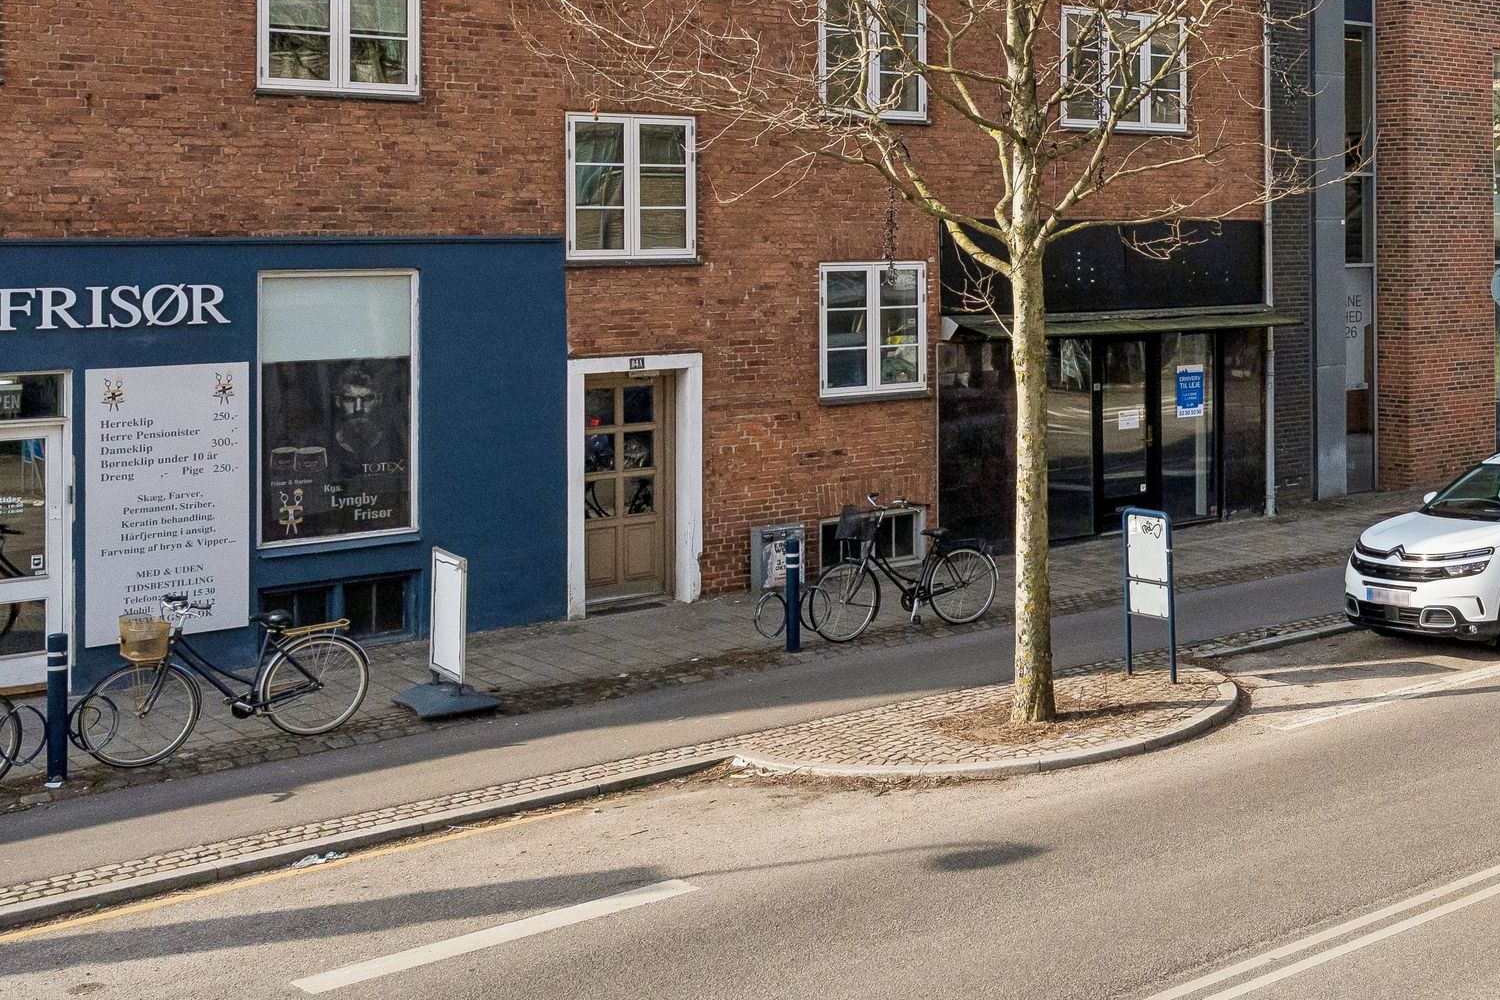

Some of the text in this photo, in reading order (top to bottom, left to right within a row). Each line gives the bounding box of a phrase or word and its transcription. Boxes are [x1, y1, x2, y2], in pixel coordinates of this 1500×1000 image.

[0, 283, 232, 331] FRISØR
[1345, 295, 1362, 308] NE
[100, 411, 239, 429] Herreklip 250,-
[100, 433, 133, 442] Herre
[136, 427, 200, 440] Pensionister
[100, 437, 239, 456] Dameklip 300,-
[100, 451, 218, 469] Børneklip under 10 år
[100, 472, 134, 482] Dreng
[182, 465, 204, 476] Pige
[137, 491, 203, 503] Skæg, Farver,
[324, 484, 343, 494] Kgs.
[123, 501, 216, 515] Permanent, Striber,
[331, 493, 378, 509] Lyngby
[121, 513, 215, 529] Keratin behandling,
[354, 508, 393, 520] Frisør
[120, 529, 178, 542] Hårfjerning
[185, 525, 216, 536] ansigt,
[100, 546, 145, 557] Farvning
[148, 543, 158, 552] af
[160, 541, 182, 551] bryn
[185, 539, 193, 548] &
[136, 563, 204, 579] MED & UDEN
[125, 575, 214, 593] TIDSBESTILLING
[123, 594, 161, 605] Telefon:
[193, 588, 203, 597] 15
[204, 587, 216, 596] 30
[124, 605, 154, 616] Mobil:
